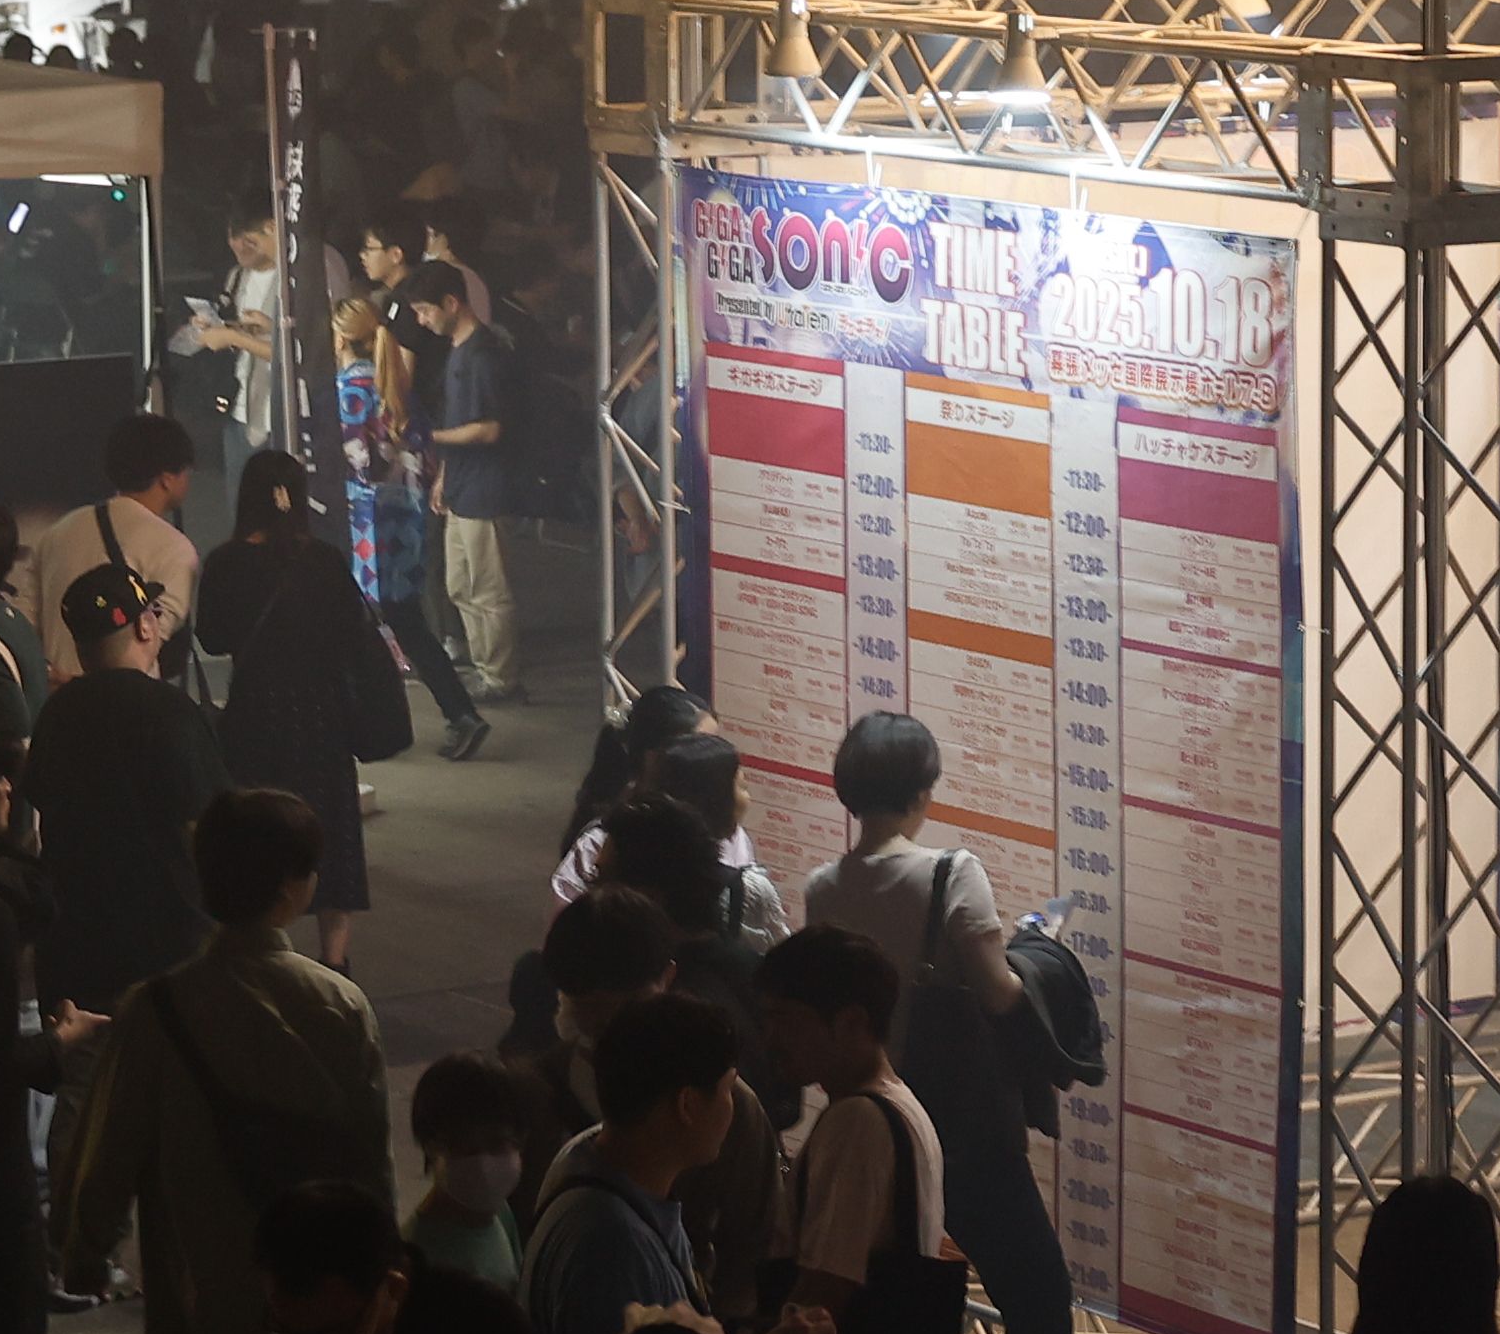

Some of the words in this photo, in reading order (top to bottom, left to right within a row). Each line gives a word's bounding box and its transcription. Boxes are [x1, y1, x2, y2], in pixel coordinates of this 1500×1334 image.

[693, 200, 743, 241] GIGA
[706, 243, 756, 284] GIGA
[930, 222, 1020, 298] TIME
[920, 297, 1030, 379] TABLE
[1050, 267, 1274, 368] 2025.10.18
